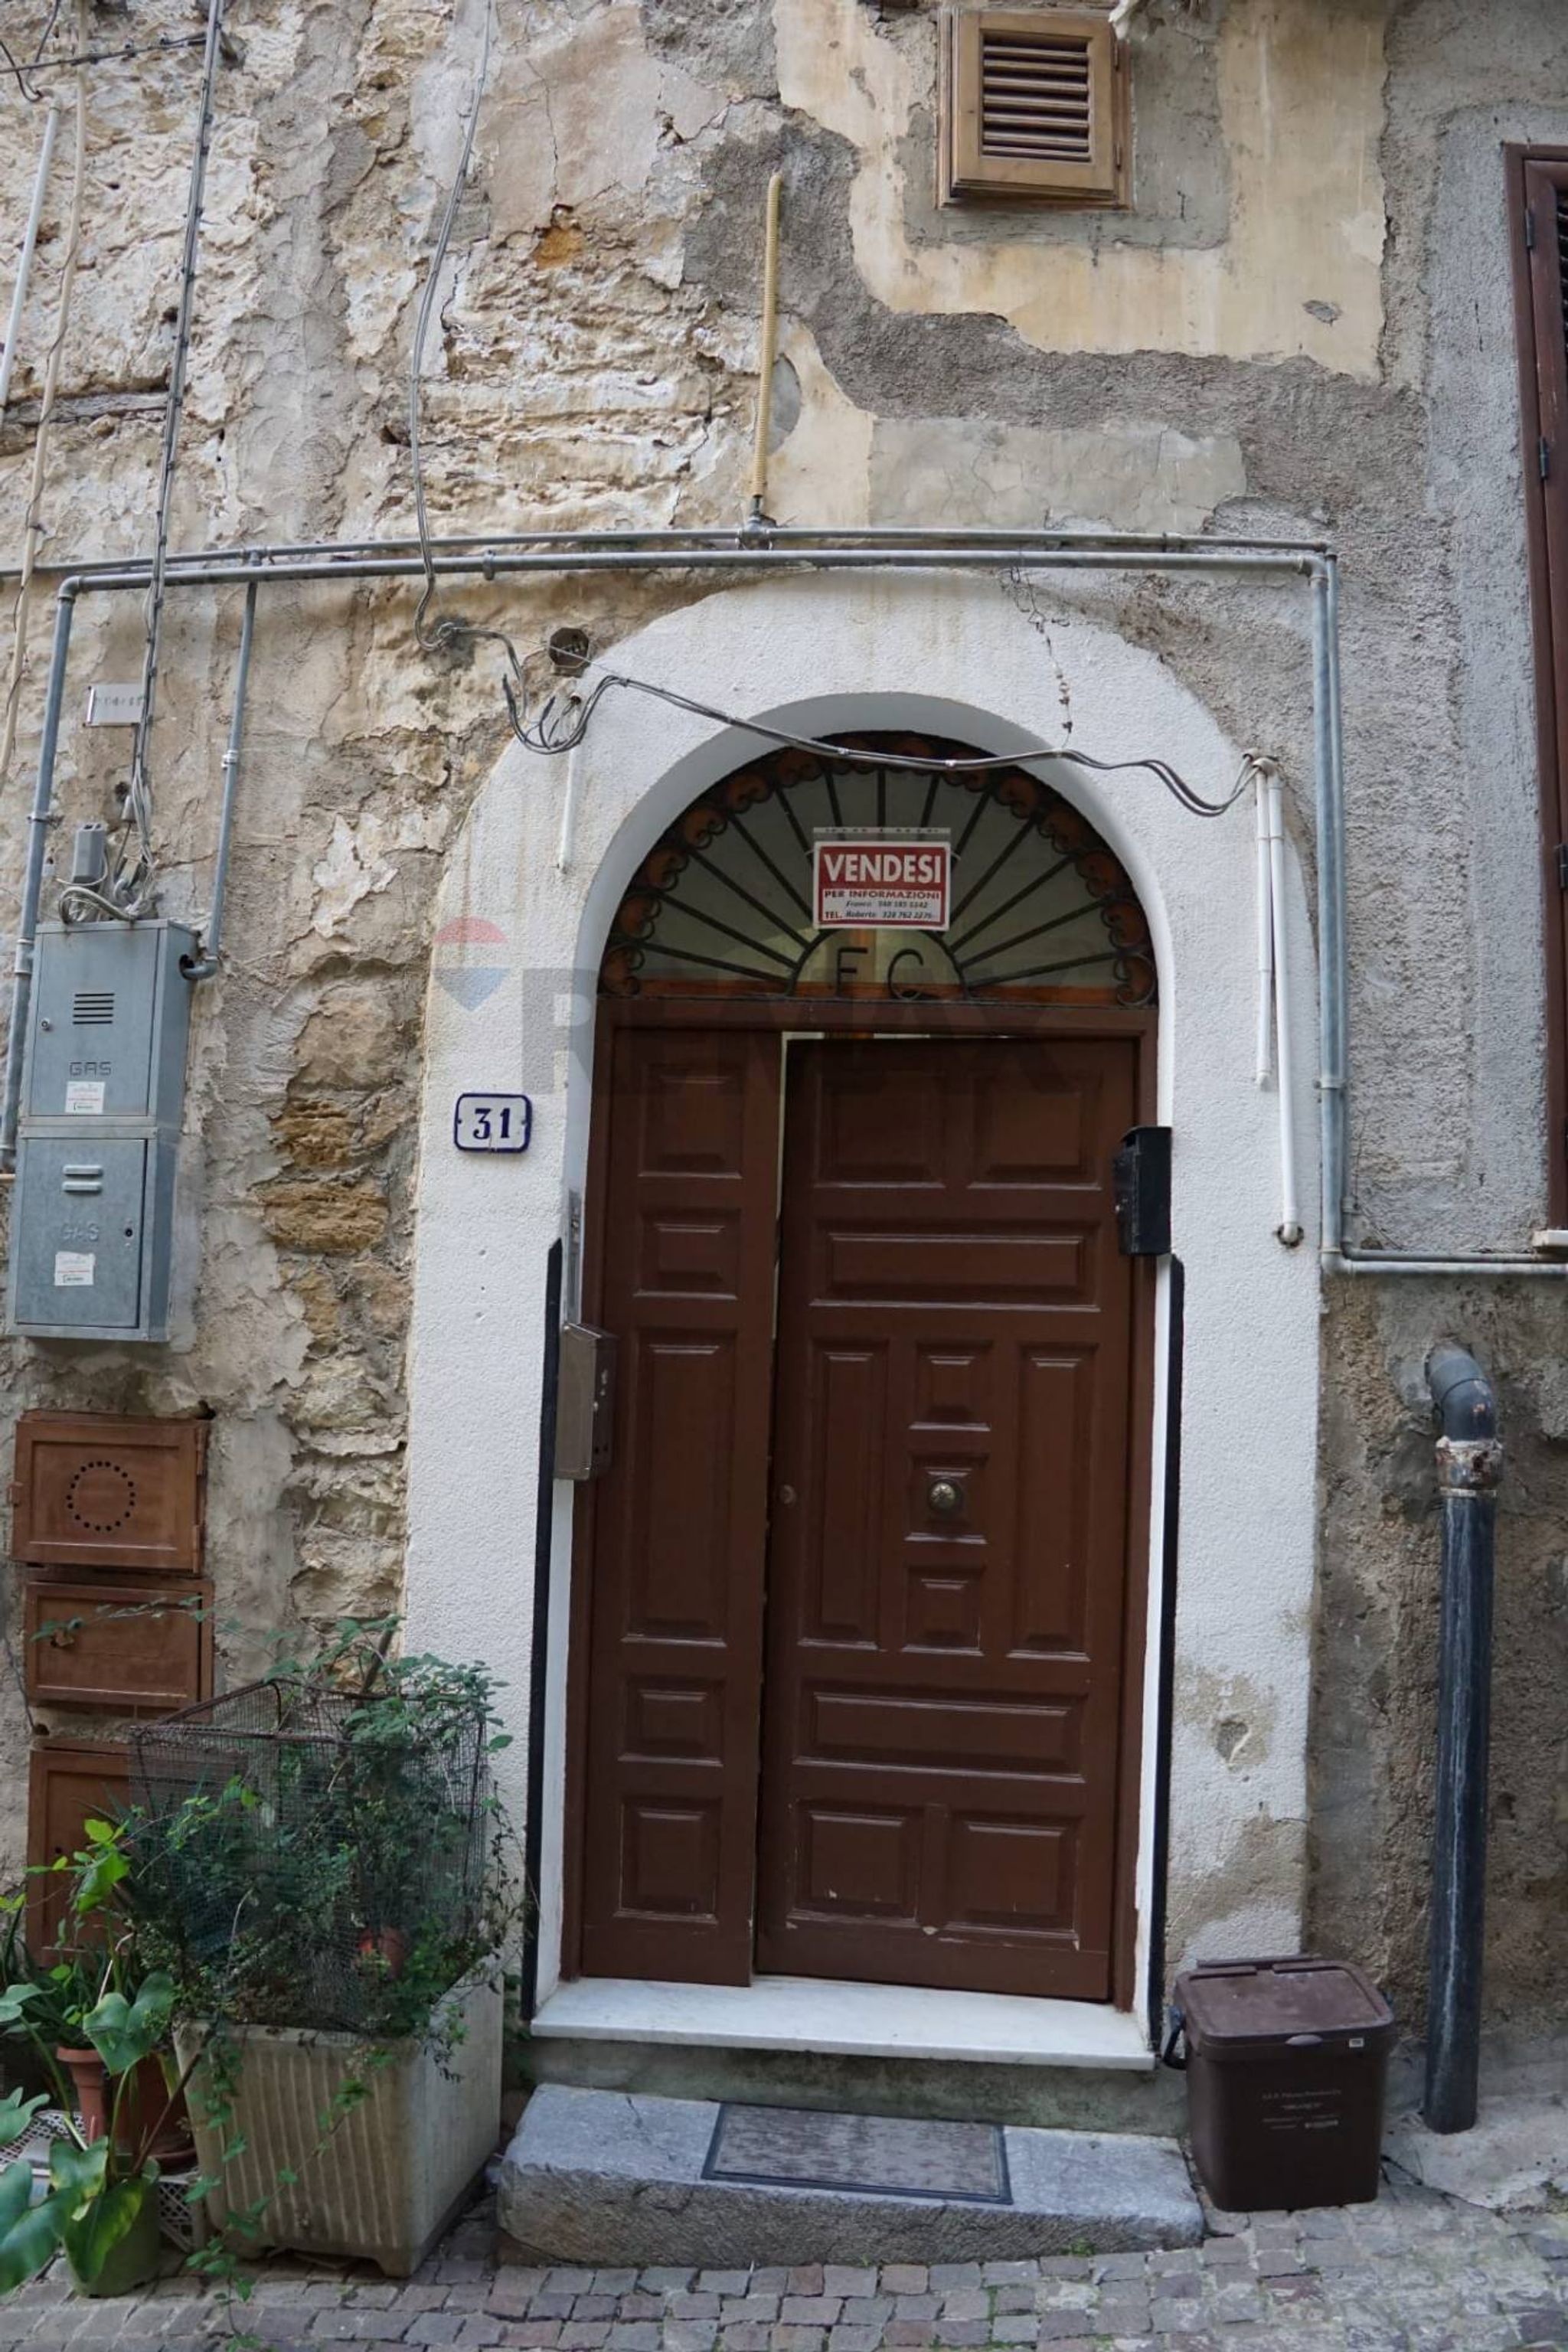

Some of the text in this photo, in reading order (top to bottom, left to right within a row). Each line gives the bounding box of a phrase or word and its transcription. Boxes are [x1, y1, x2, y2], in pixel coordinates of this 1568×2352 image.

[824, 854, 942, 884] VENDESI
[849, 890, 939, 899] INFORMAZIONI
[69, 1060, 112, 1076] GAS
[472, 1107, 511, 1140] 31
